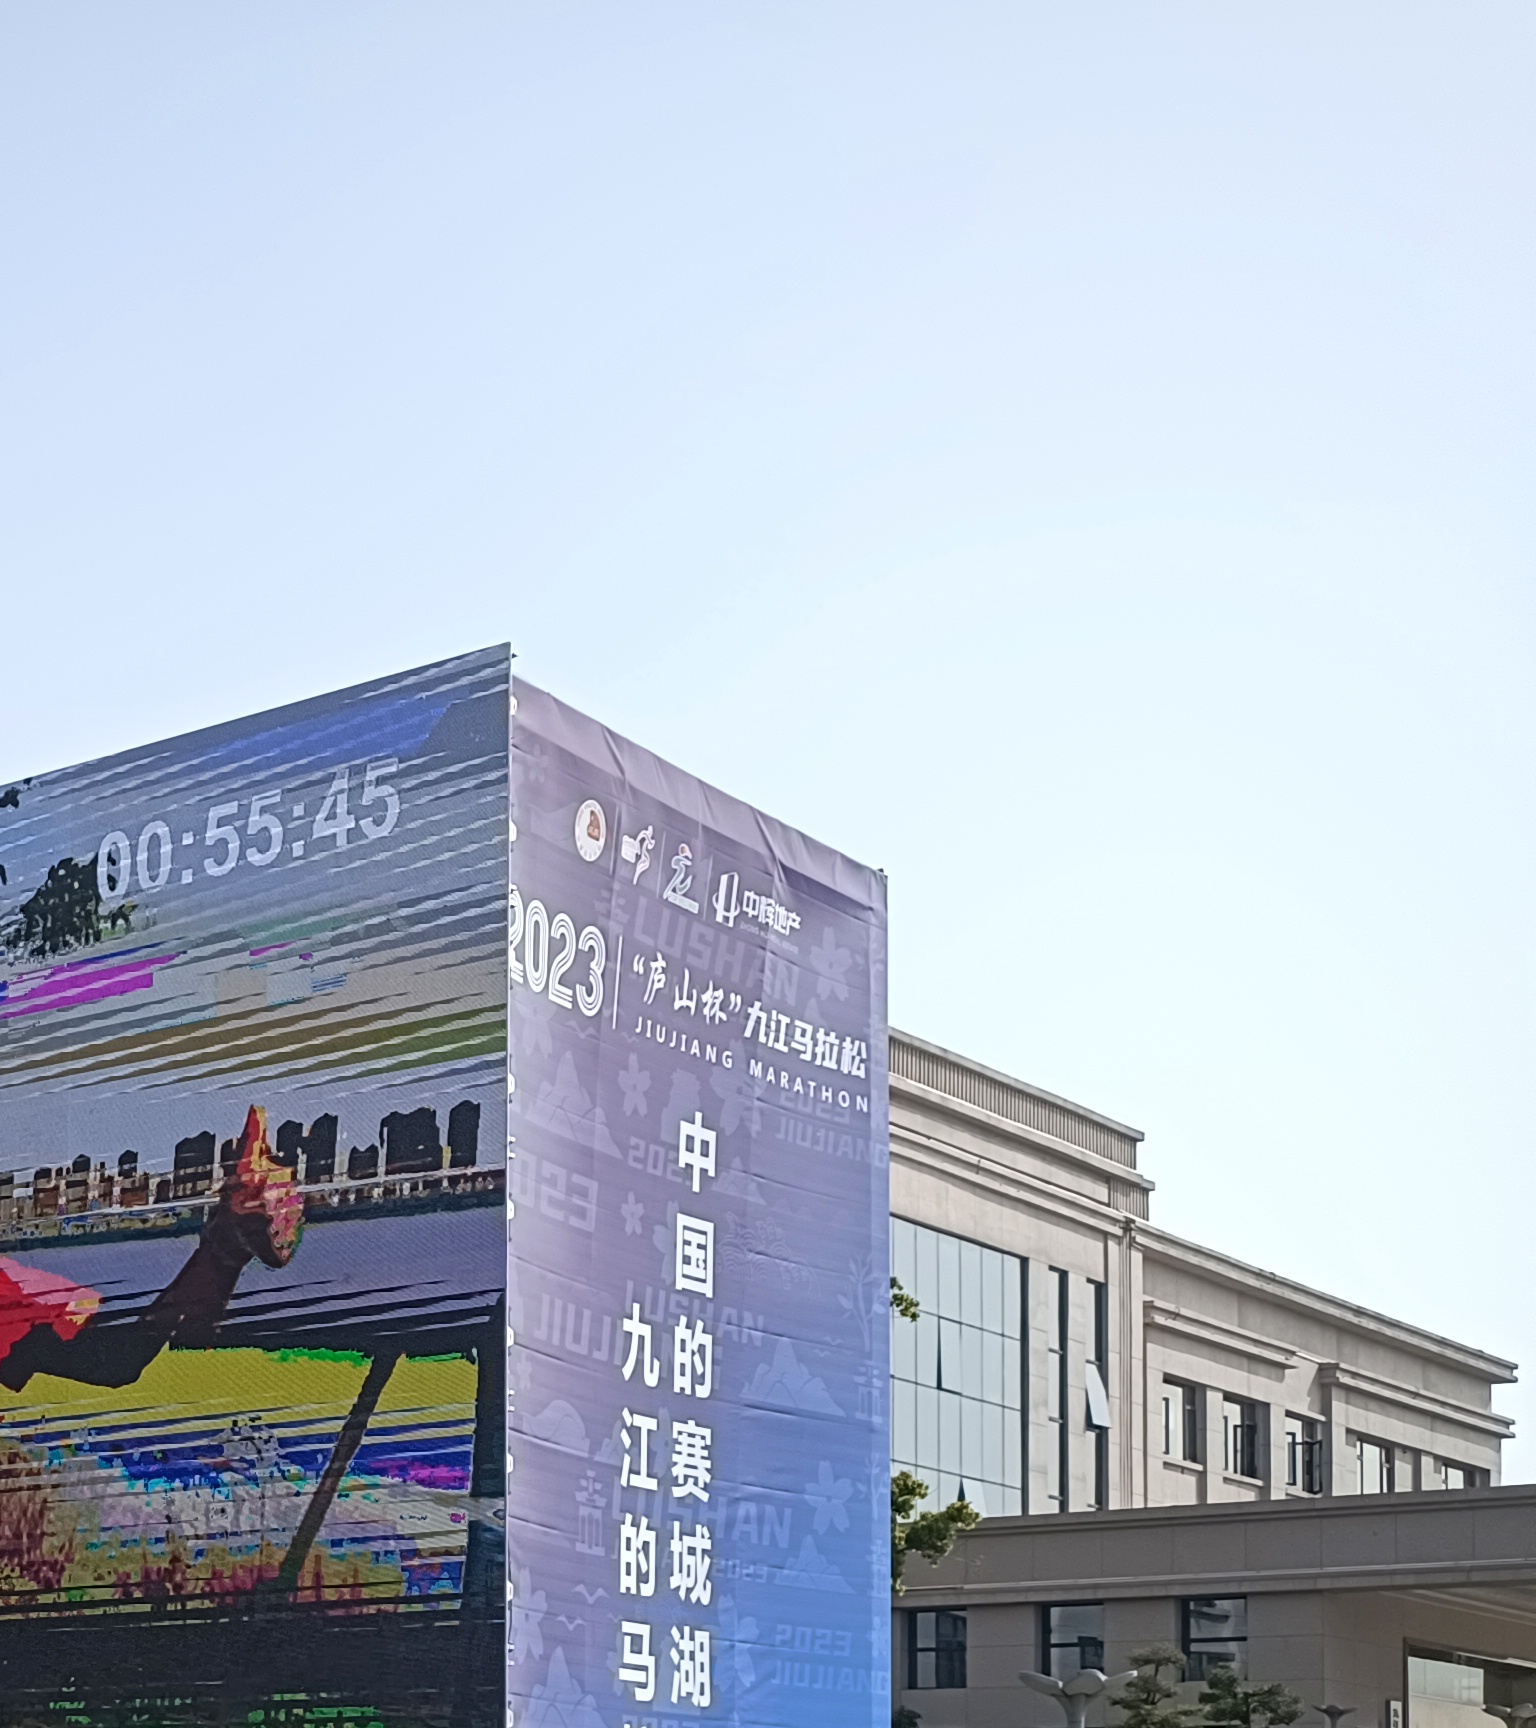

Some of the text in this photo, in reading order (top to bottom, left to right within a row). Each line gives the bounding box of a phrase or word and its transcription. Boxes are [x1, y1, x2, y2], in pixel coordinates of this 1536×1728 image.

[97, 757, 401, 901] 00:55:45
[508, 885, 607, 1017] 2023
[742, 890, 801, 936] 中辉地产
[634, 1015, 869, 1113] JIUJIANG MARATHON
[669, 1110, 718, 1708] 中国的赛城湖
